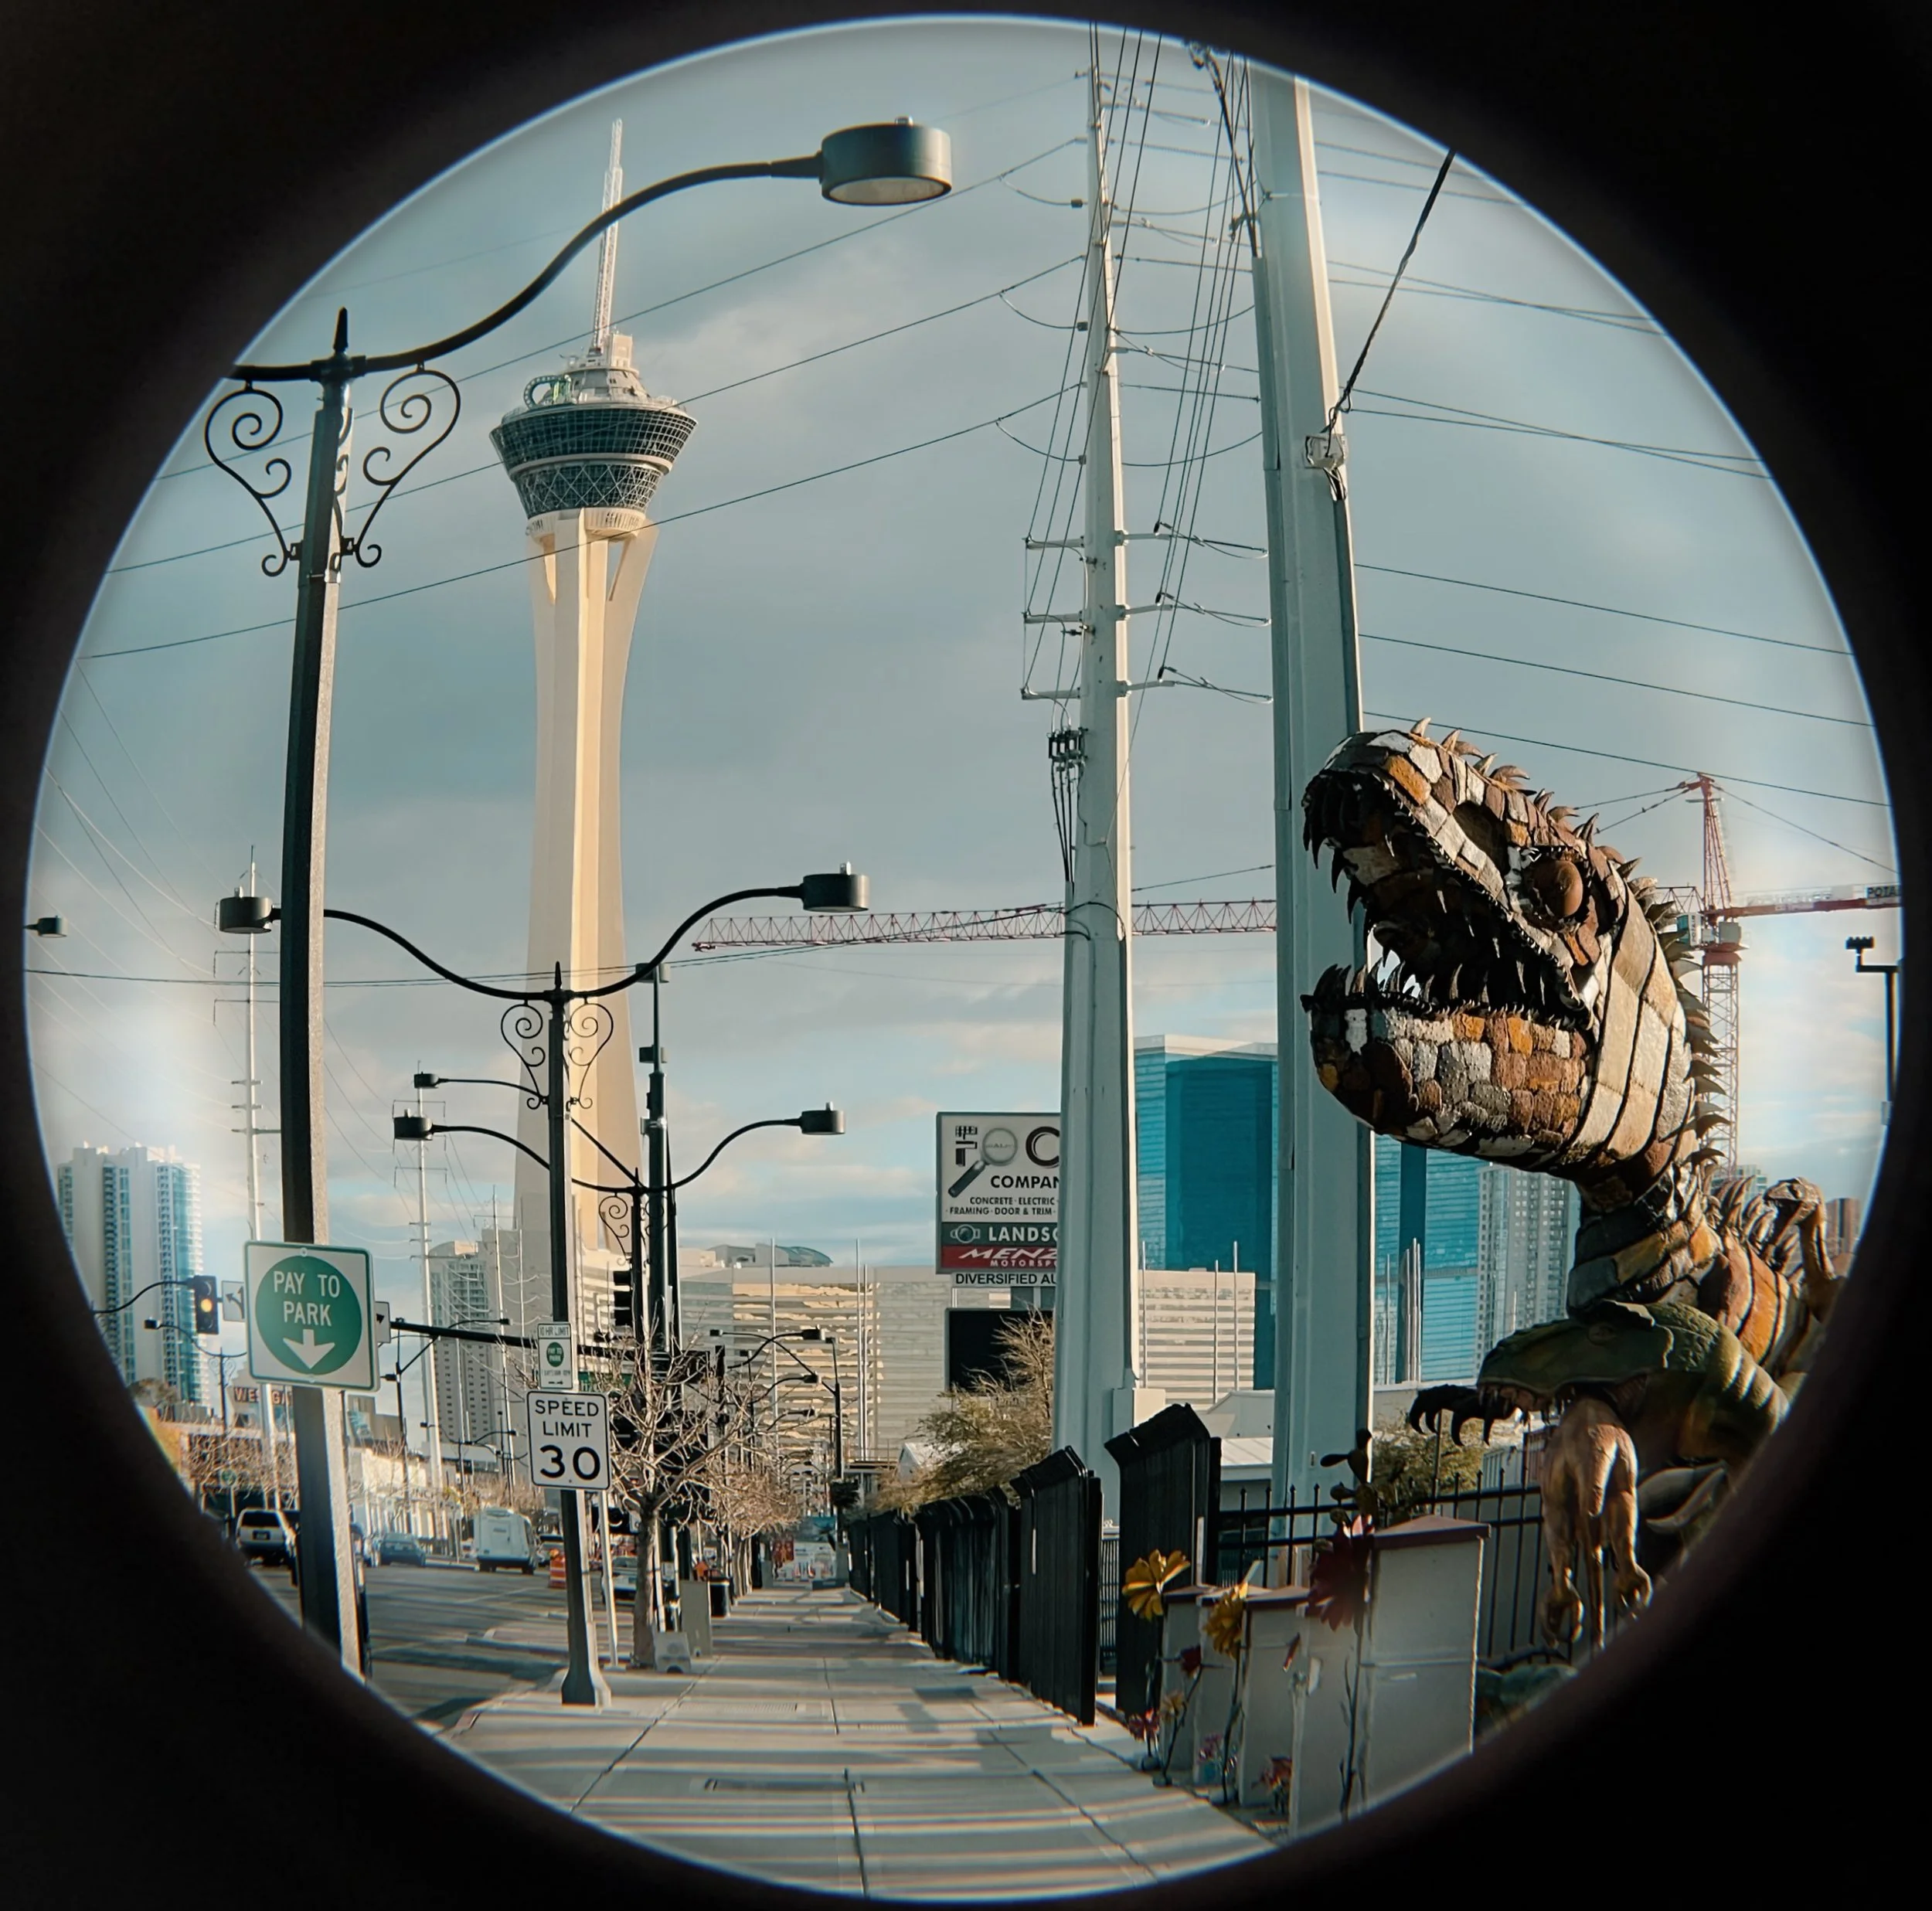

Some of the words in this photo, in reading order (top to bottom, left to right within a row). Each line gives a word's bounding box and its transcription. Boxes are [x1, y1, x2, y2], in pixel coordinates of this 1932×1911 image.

[970, 1196, 1013, 1205] CONCRETE
[1019, 1196, 1055, 1205] ELECTRIC
[950, 1206, 989, 1215] FRAMING
[274, 1270, 305, 1295] PAY
[317, 1273, 340, 1298] TO
[955, 1273, 1037, 1284] DIVERSIFIED
[283, 1301, 332, 1327] PARK
[535, 1399, 600, 1417] SPEED
[543, 1421, 592, 1438] LIMIT
[539, 1444, 600, 1481] 30
